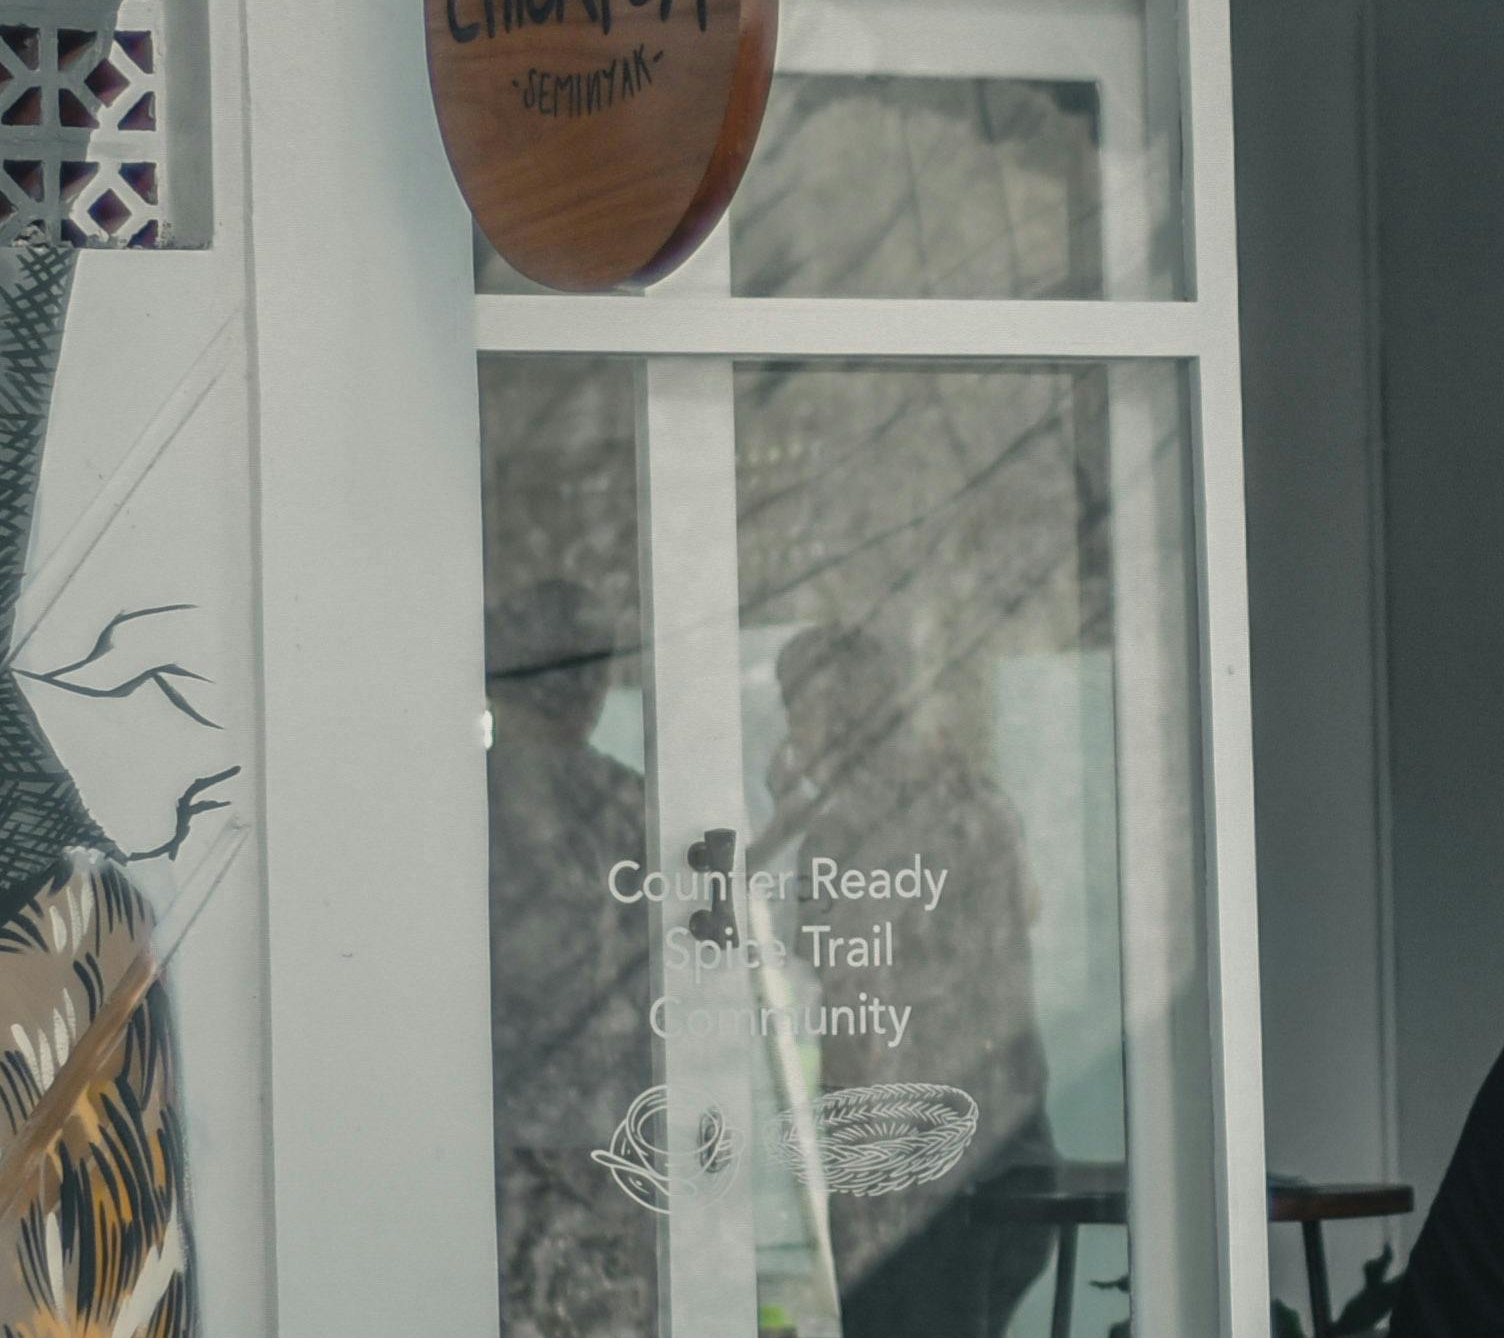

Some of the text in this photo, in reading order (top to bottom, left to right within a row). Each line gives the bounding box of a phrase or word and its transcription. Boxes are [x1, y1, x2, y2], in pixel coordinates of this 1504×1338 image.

[608, 853, 949, 911] Counter Ready
[664, 921, 894, 984] Spice Trail
